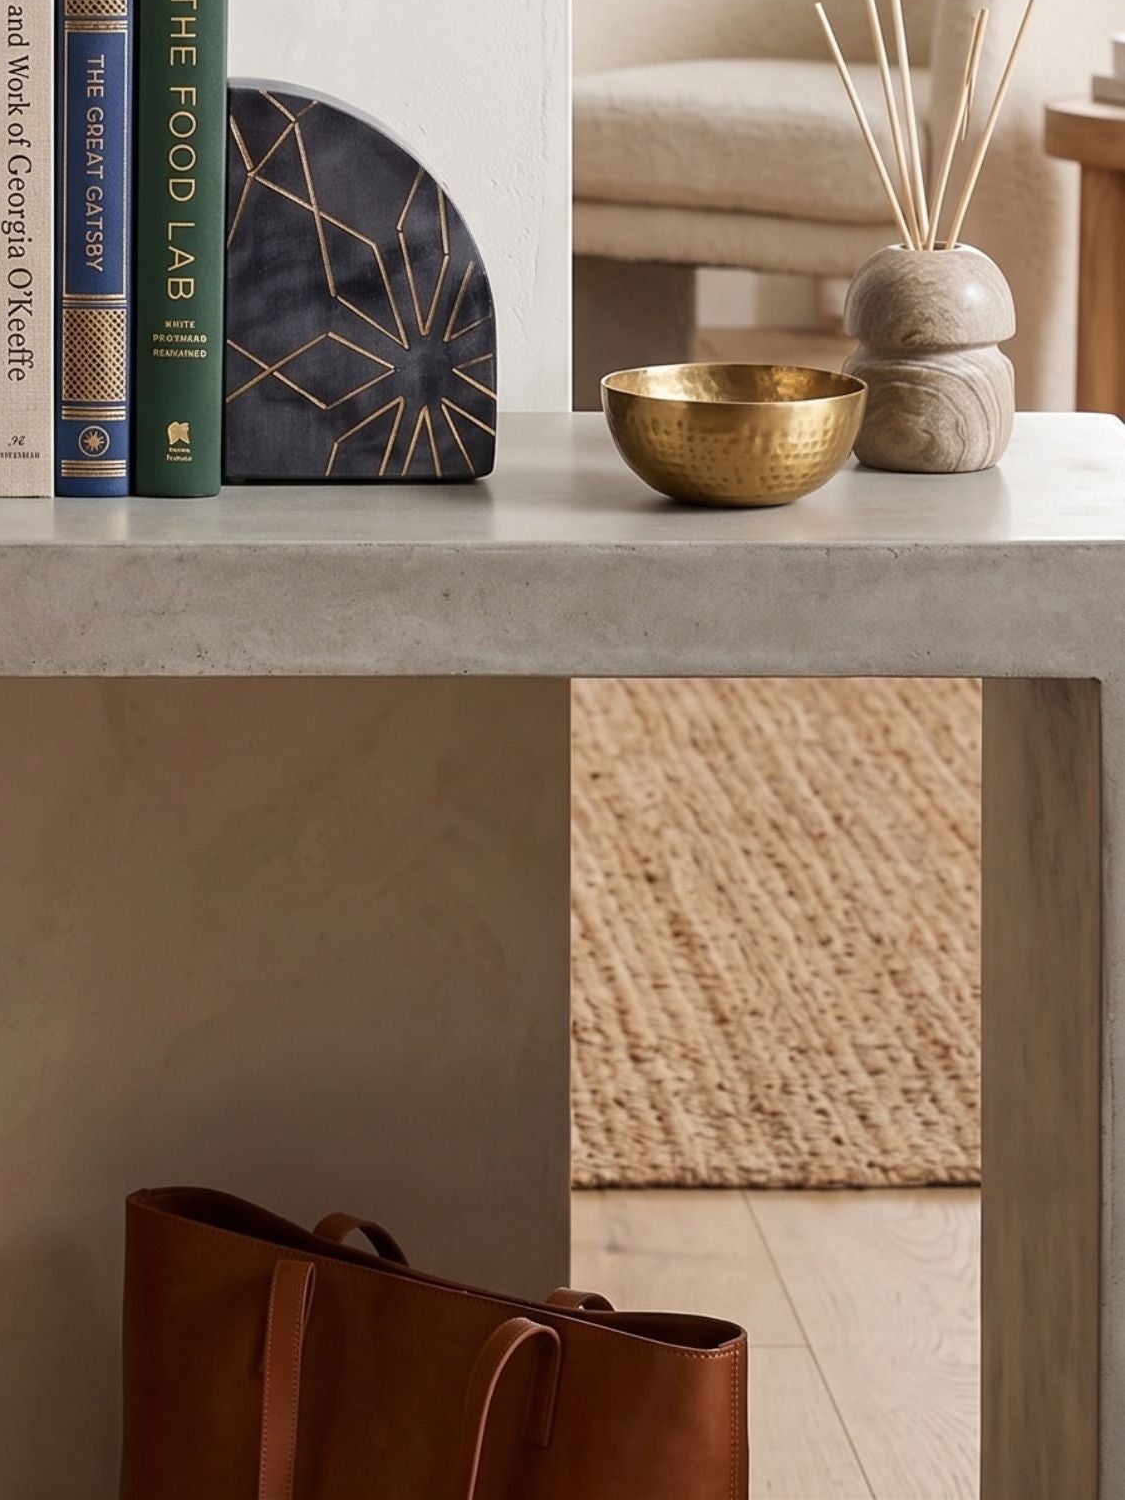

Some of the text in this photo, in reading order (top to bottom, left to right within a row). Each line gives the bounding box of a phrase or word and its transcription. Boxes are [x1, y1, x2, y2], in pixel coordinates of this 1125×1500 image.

[7, 6, 29, 47] and
[7, 54, 31, 115] Work
[7, 121, 32, 146] of
[85, 54, 105, 273] THE GREAT GATSBY
[167, 87, 197, 203] FOOD
[1, 154, 33, 259] Georgia
[167, 222, 196, 300] LAB
[7, 268, 33, 382] O'Keeffe
